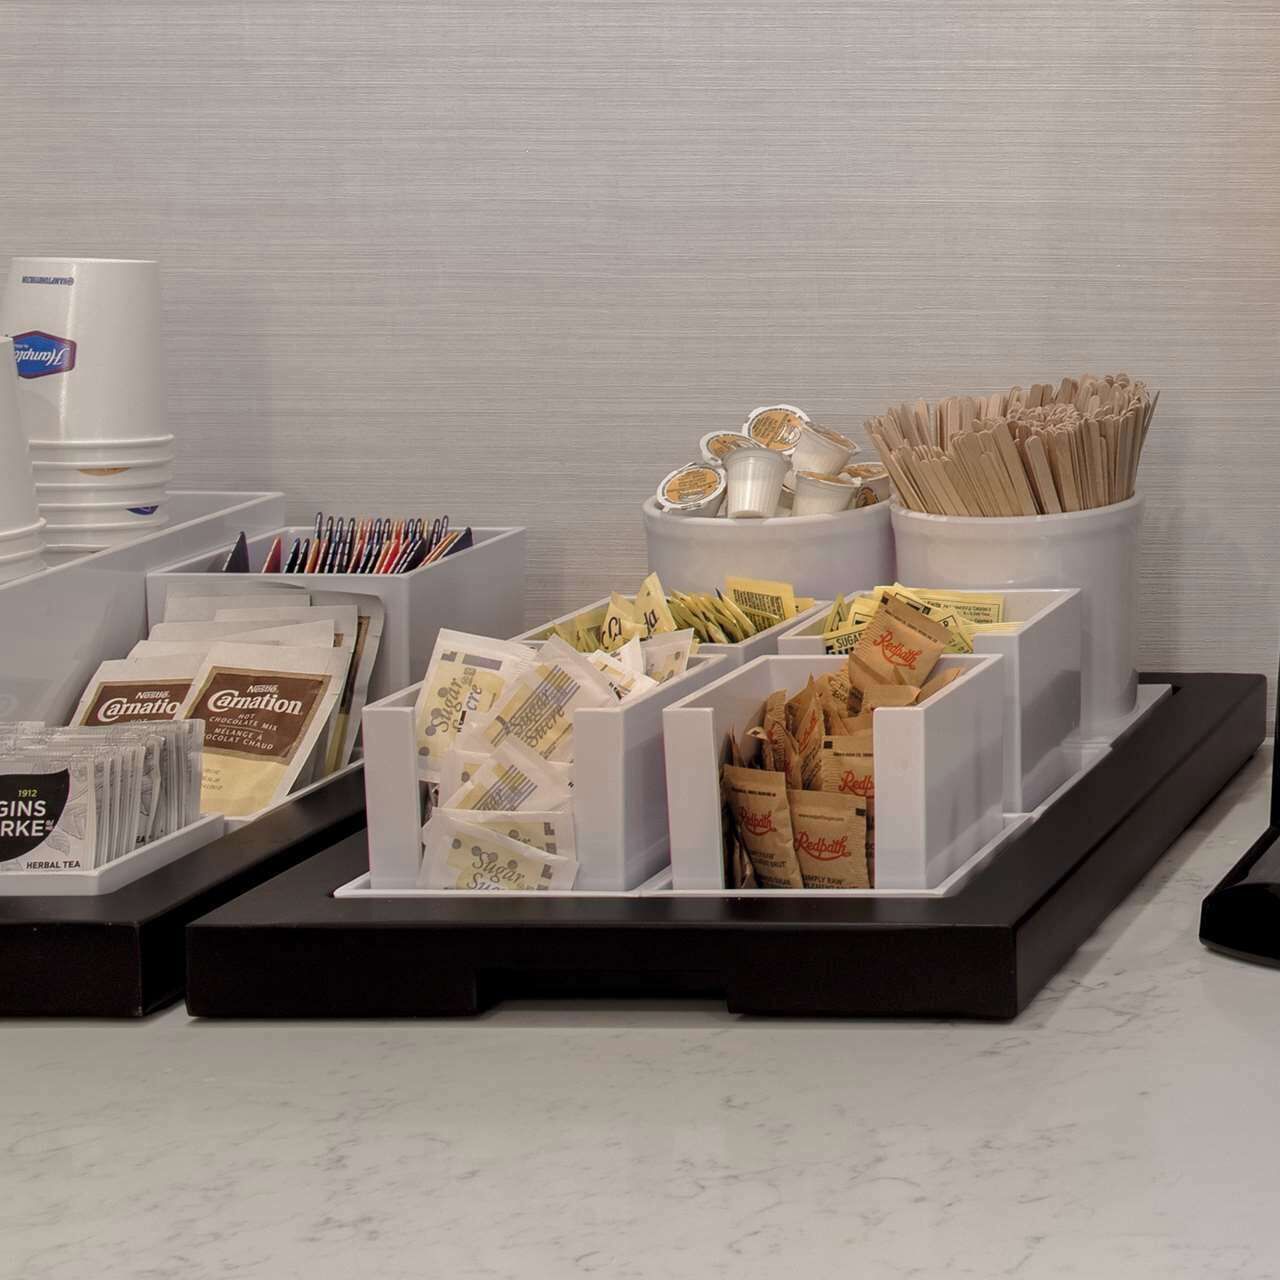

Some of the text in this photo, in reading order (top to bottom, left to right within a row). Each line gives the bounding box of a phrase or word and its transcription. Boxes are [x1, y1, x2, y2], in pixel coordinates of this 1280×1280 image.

[208, 690, 303, 715] Carnation
[262, 723, 278, 732] MIX
[18, 789, 38, 798] 1912
[1, 820, 45, 837] RKE
[26, 860, 81, 869] HERBAL TEA
[472, 851, 526, 884] Sugar
